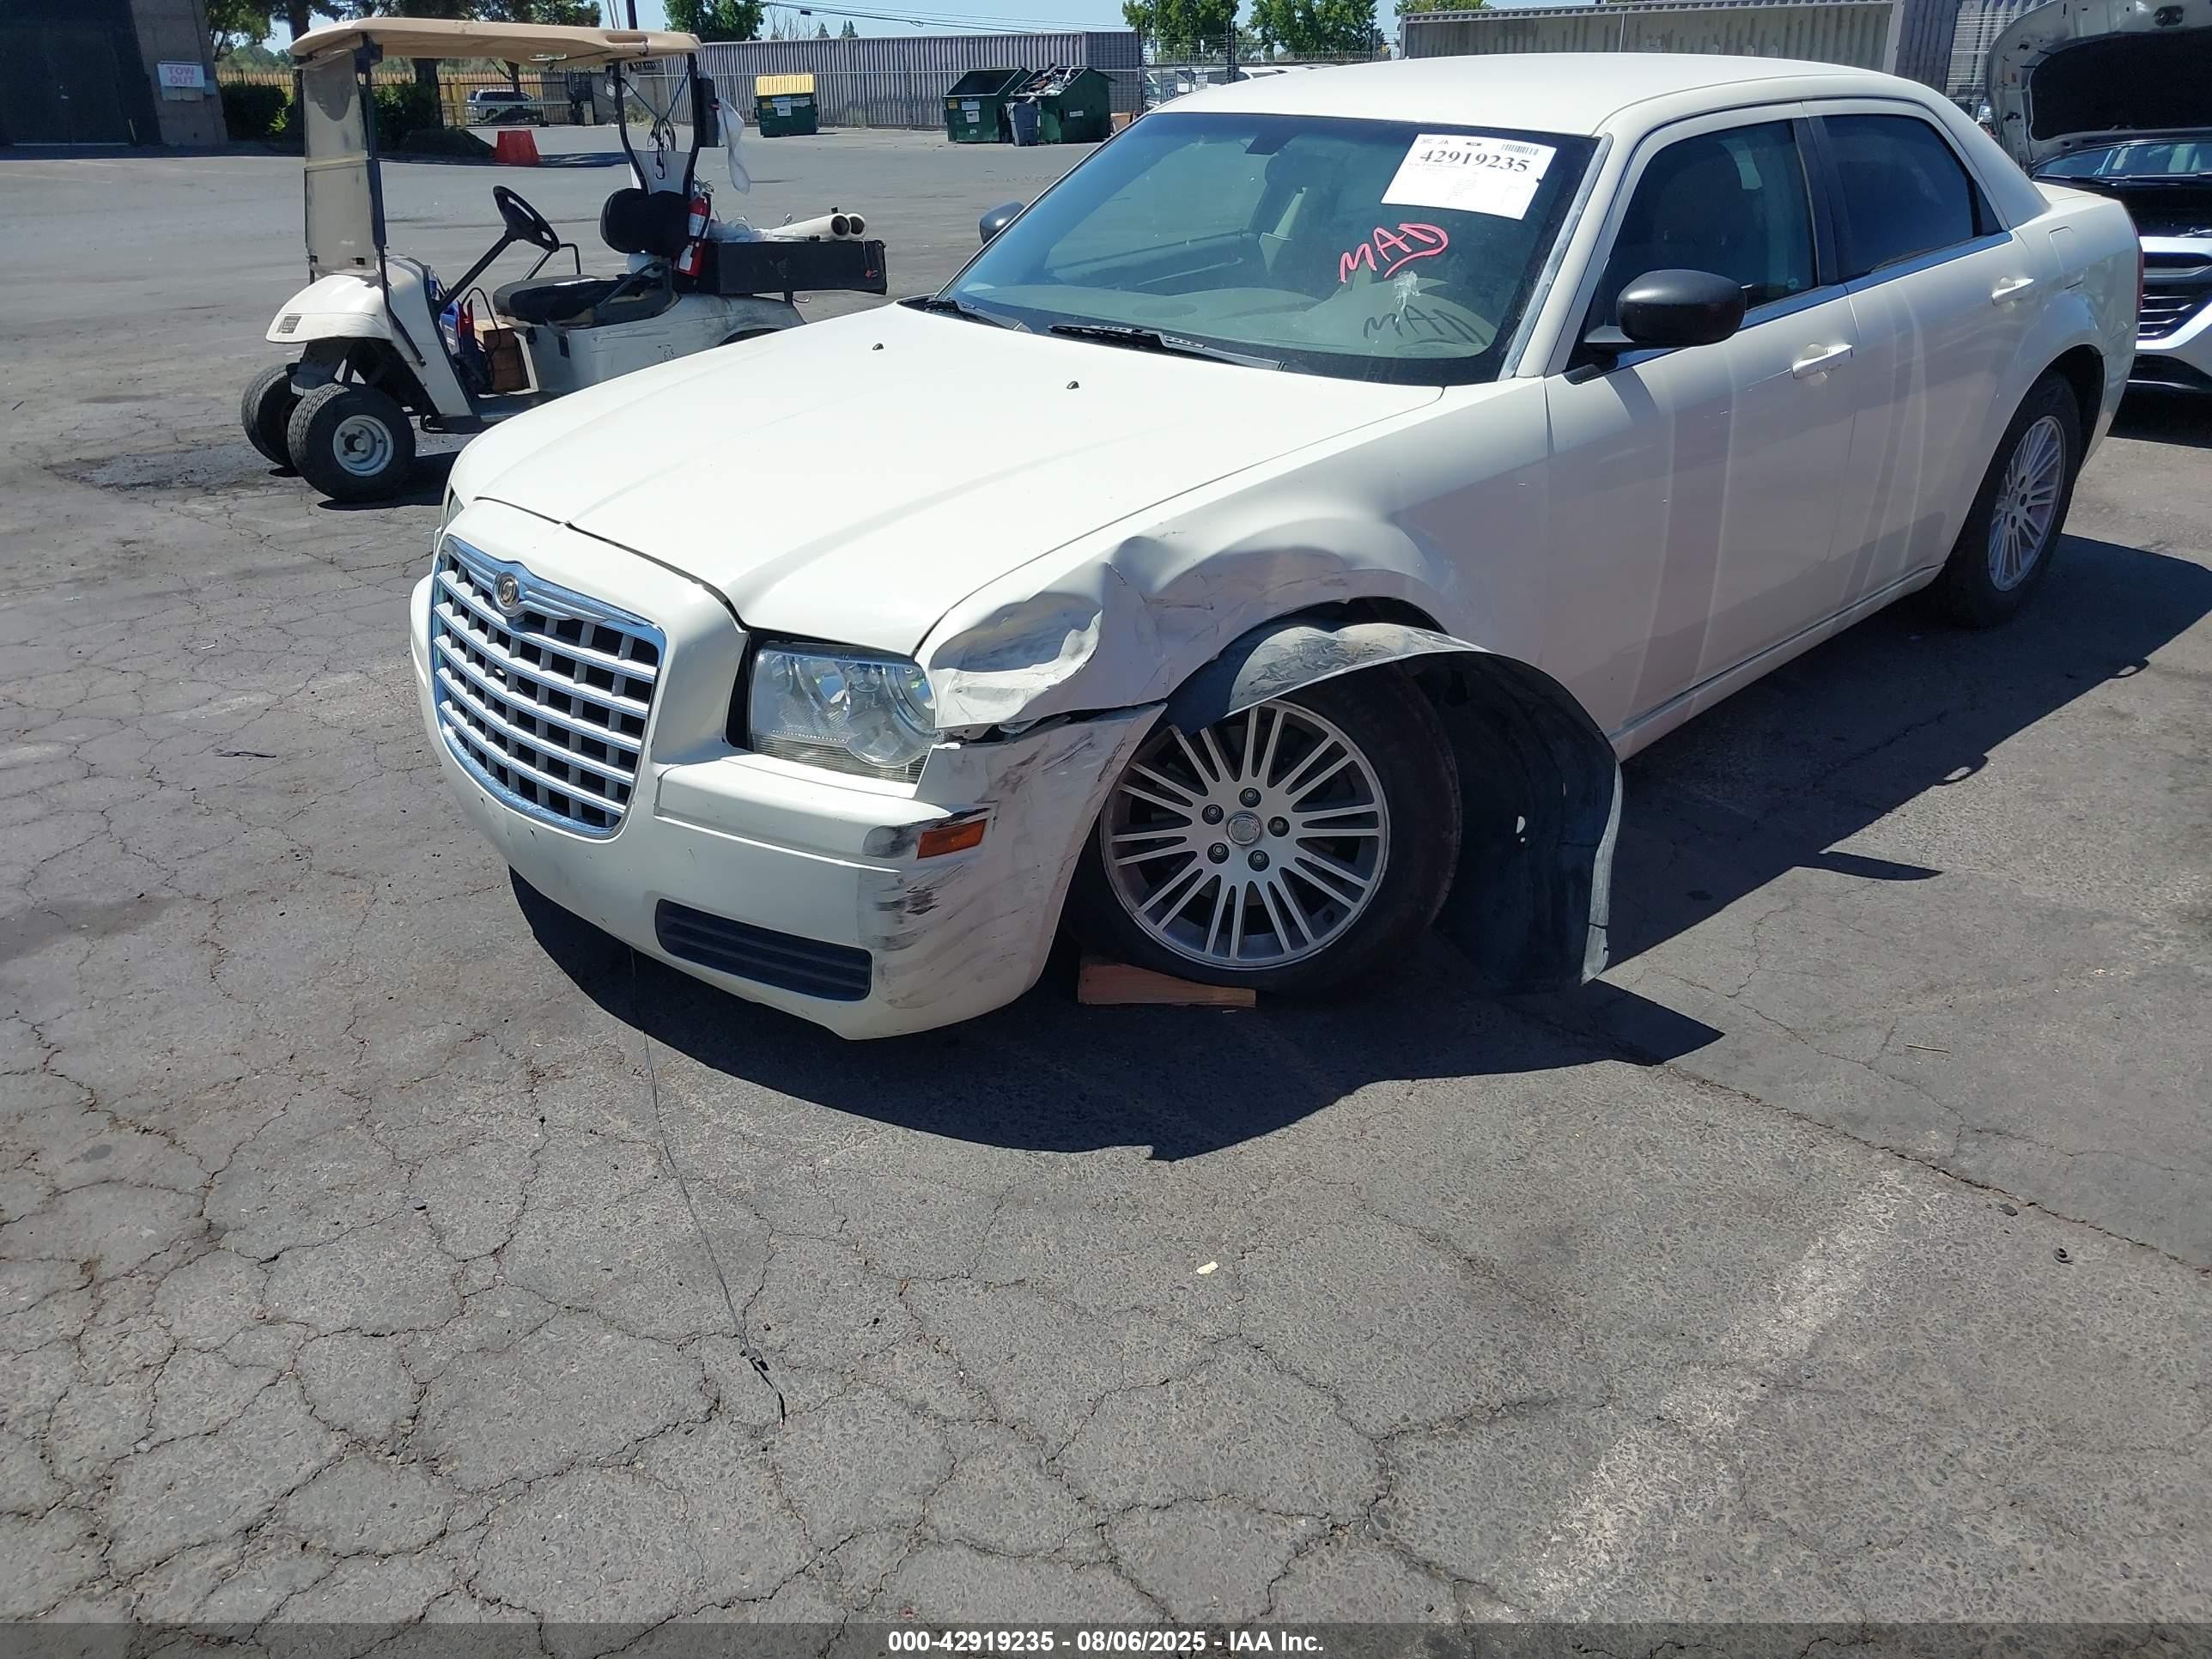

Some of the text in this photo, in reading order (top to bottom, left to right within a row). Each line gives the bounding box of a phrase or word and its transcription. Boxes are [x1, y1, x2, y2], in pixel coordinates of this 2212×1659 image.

[167, 66, 195, 76] TOW
[169, 76, 196, 84] OUT
[1164, 88, 1176, 98] 10
[1419, 149, 1531, 172] 42919235
[1339, 223, 1449, 284] MAD
